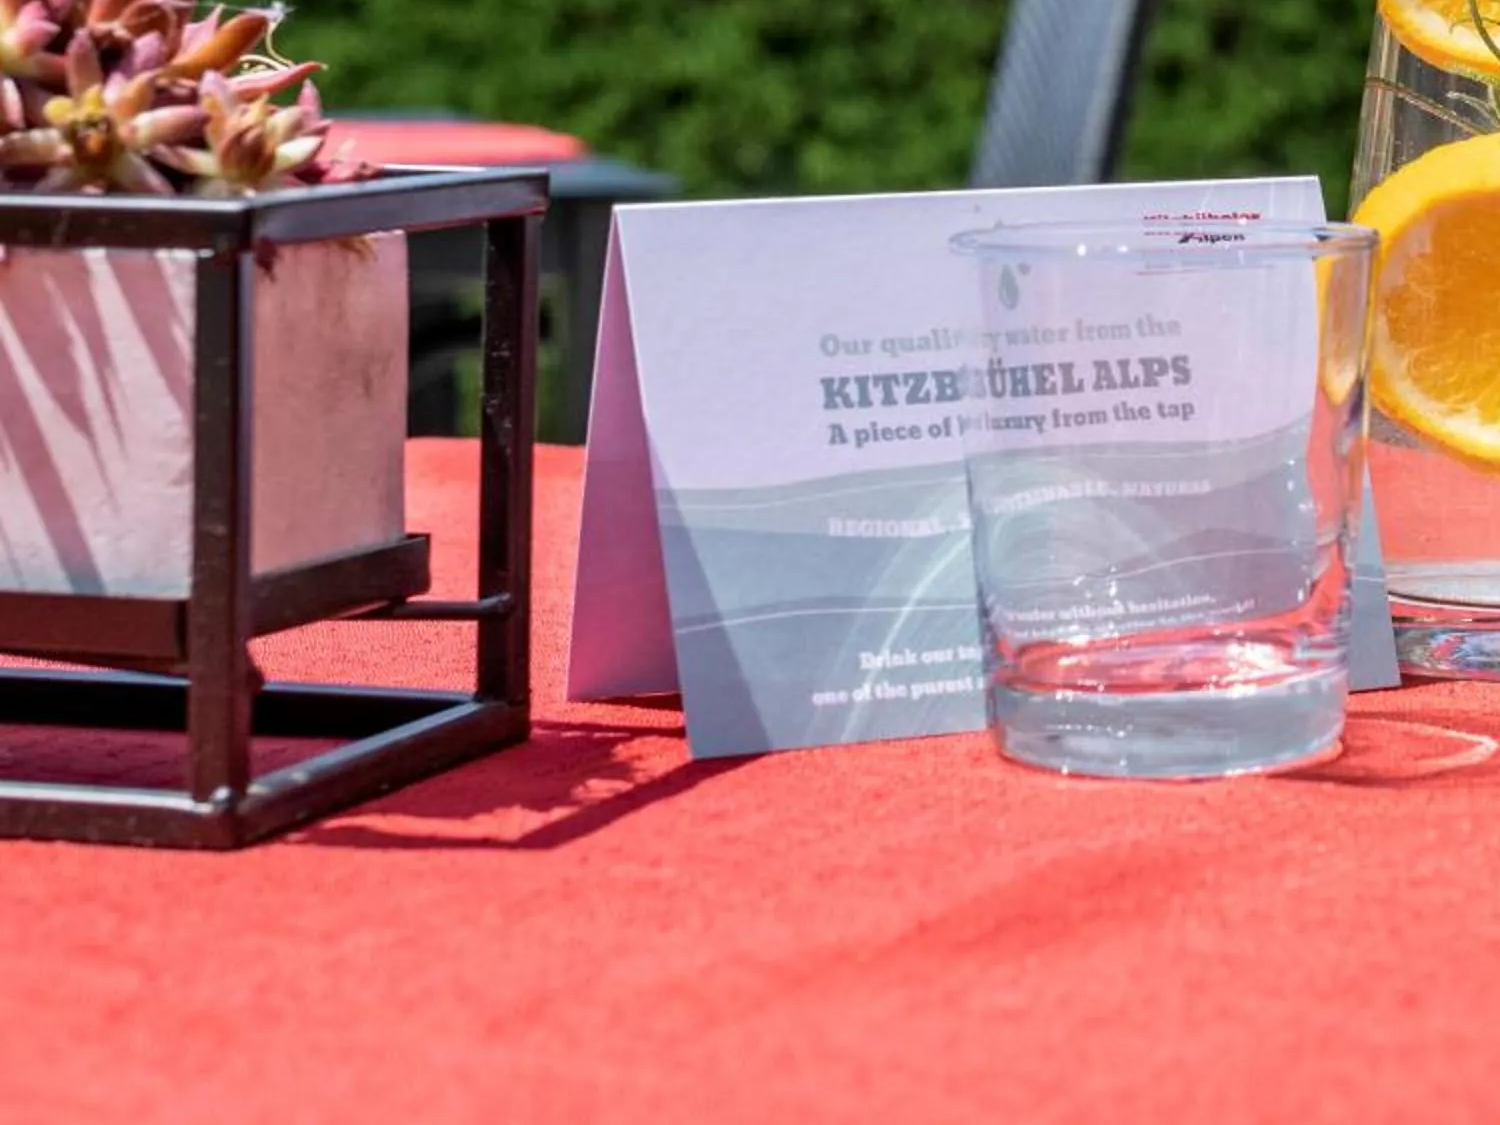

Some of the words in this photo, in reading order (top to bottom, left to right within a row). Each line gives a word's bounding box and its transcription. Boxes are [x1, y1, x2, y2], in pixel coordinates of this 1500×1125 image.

[819, 333, 872, 357] Our
[1076, 318, 1131, 342] from
[1136, 313, 1182, 338] the
[820, 357, 1085, 410] KITZBÜHEL
[1092, 355, 1192, 391] ALPS
[828, 423, 848, 445] A
[854, 421, 923, 449] piece
[928, 416, 952, 438] of
[1052, 408, 1108, 428] from
[1113, 401, 1151, 422] the
[1157, 401, 1195, 422] tap
[874, 681, 907, 699] the
